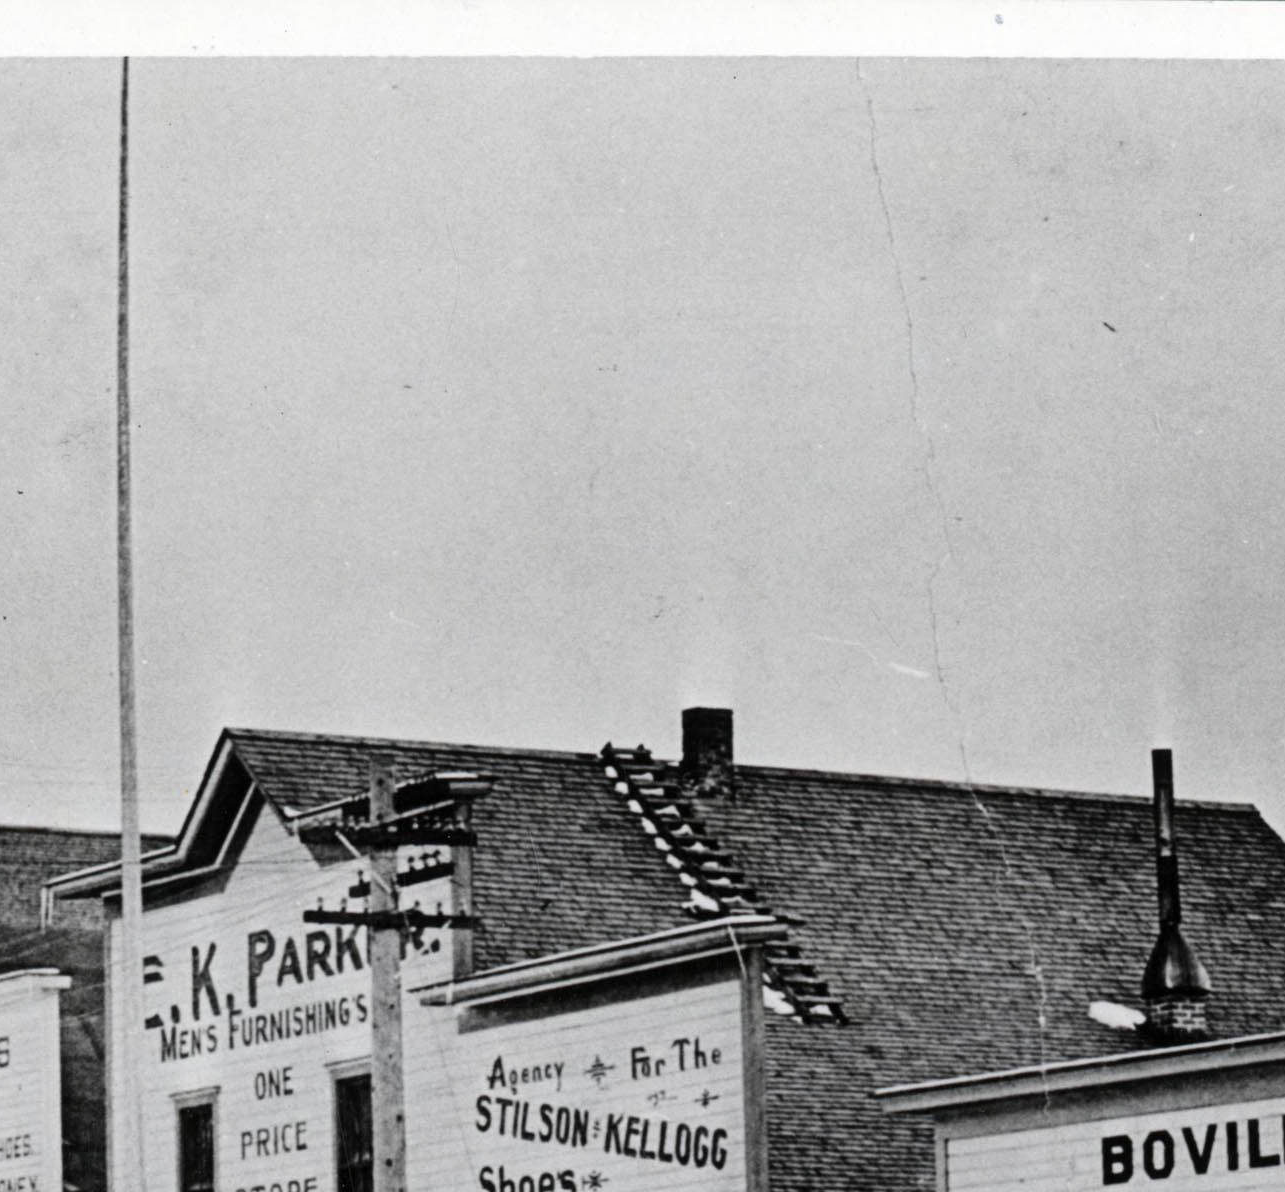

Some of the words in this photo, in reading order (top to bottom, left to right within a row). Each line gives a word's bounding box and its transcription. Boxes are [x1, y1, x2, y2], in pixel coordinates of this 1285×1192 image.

[191, 942, 235, 1021] K.
[254, 1066, 294, 1101] ONE
[486, 1054, 565, 1096] Agency
[630, 1046, 666, 1081] For
[670, 1037, 723, 1073] The
[240, 1121, 308, 1160] PRICE
